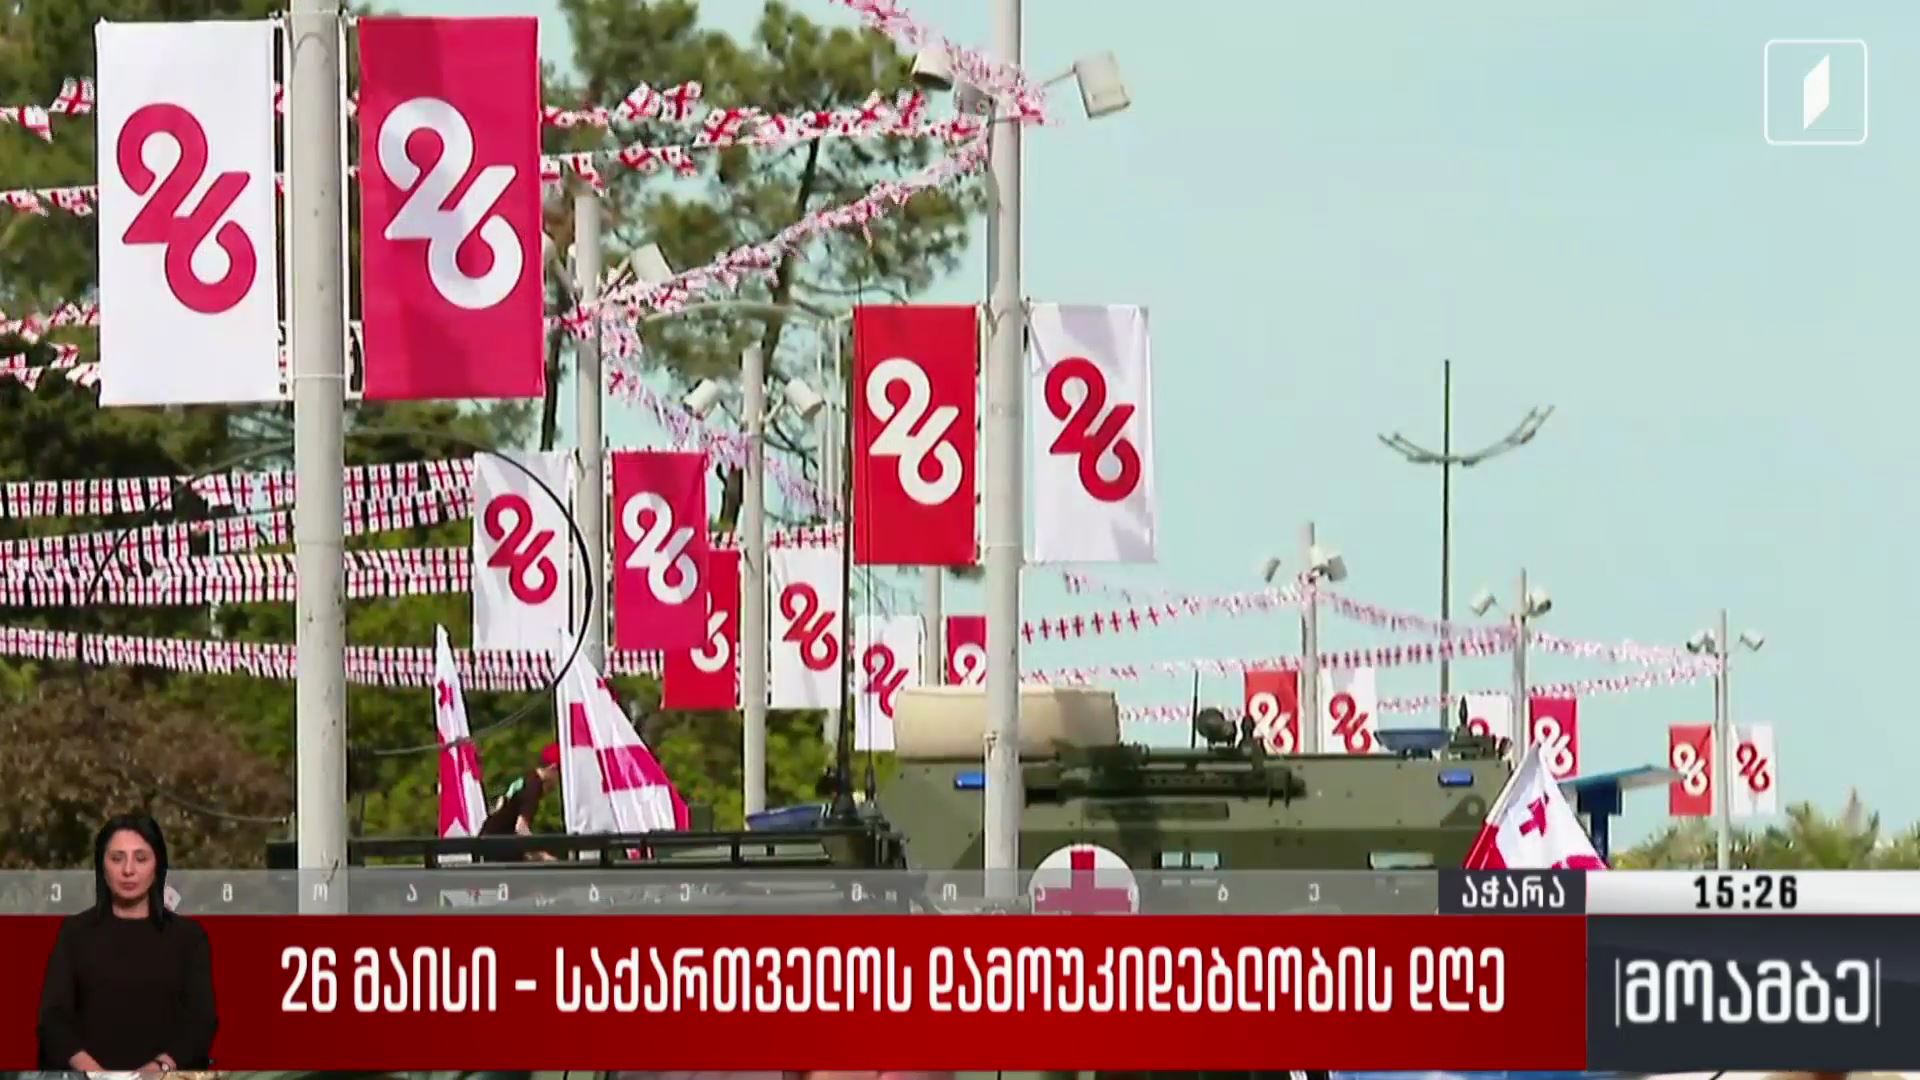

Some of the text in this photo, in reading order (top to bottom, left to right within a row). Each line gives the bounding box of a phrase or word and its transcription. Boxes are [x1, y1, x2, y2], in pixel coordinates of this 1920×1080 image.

[117, 103, 257, 314] 26
[379, 97, 524, 309] 26
[866, 357, 963, 505] 26
[1045, 357, 1141, 502] 26
[484, 494, 557, 605] 26
[622, 492, 698, 605] 26
[690, 592, 730, 673] 6
[780, 582, 838, 671] 26
[1249, 692, 1294, 754] 26
[1329, 693, 1372, 754] 26
[1736, 742, 1770, 792] 26
